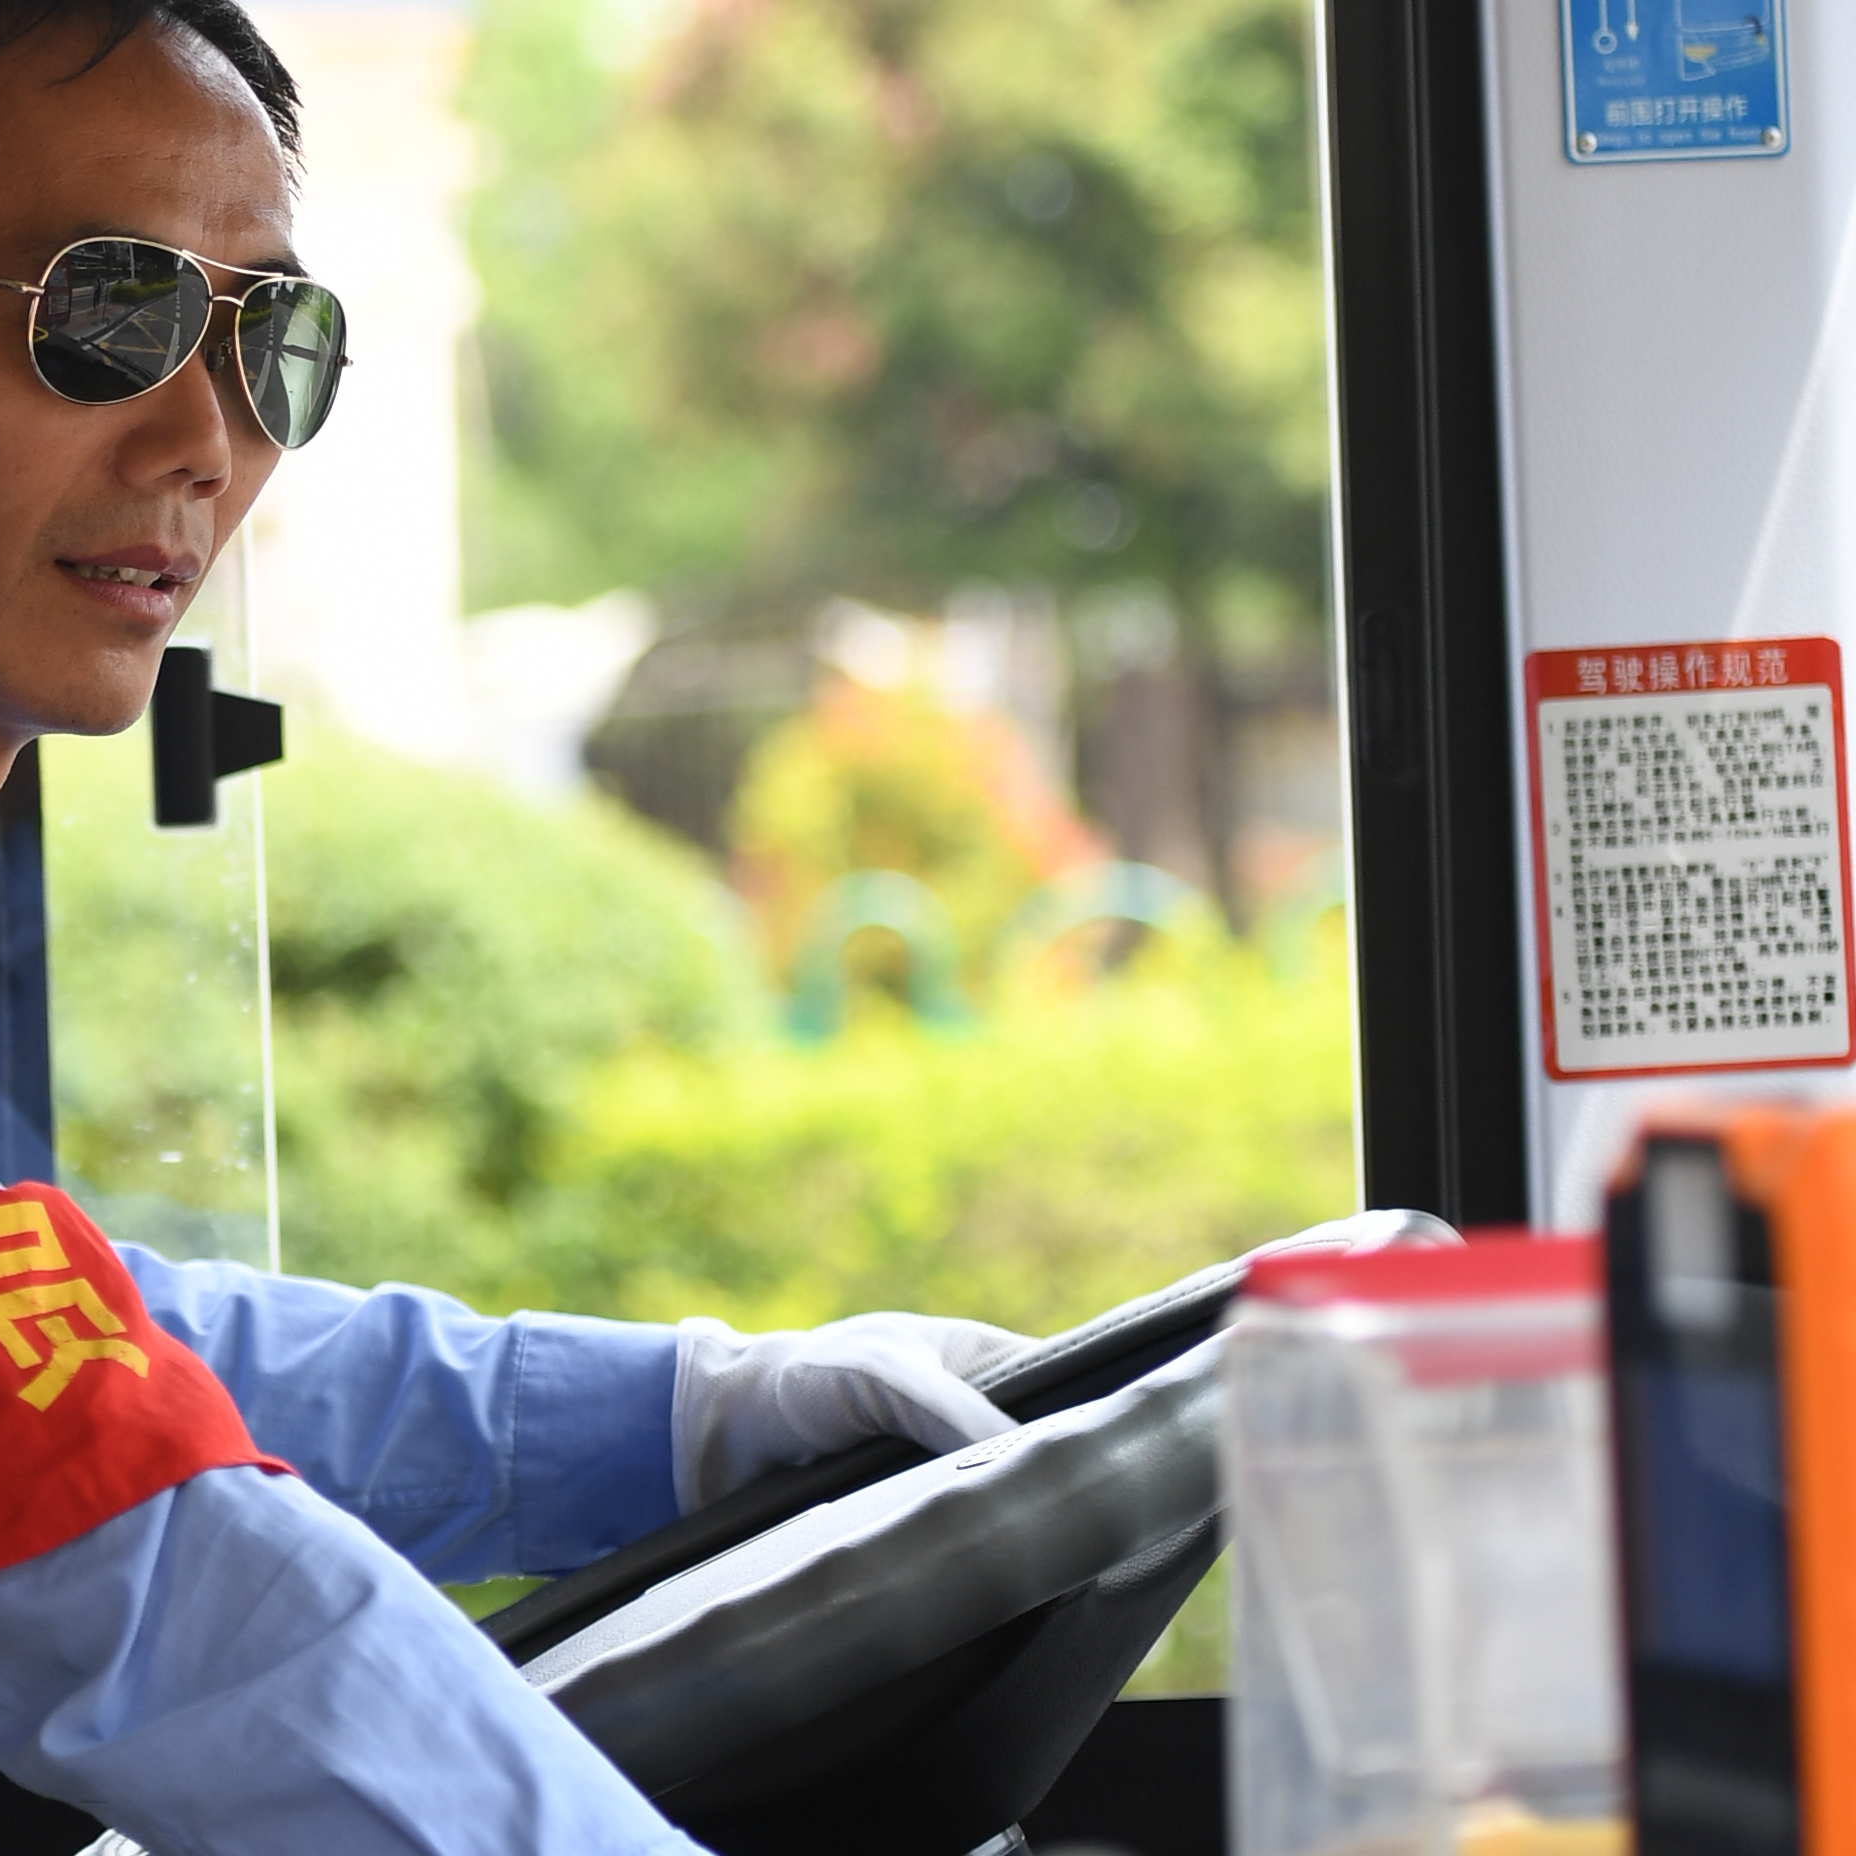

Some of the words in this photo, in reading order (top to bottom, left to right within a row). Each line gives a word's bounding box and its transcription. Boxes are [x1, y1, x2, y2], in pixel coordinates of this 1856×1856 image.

[1576, 648, 1790, 695] 驾驶操作规范
